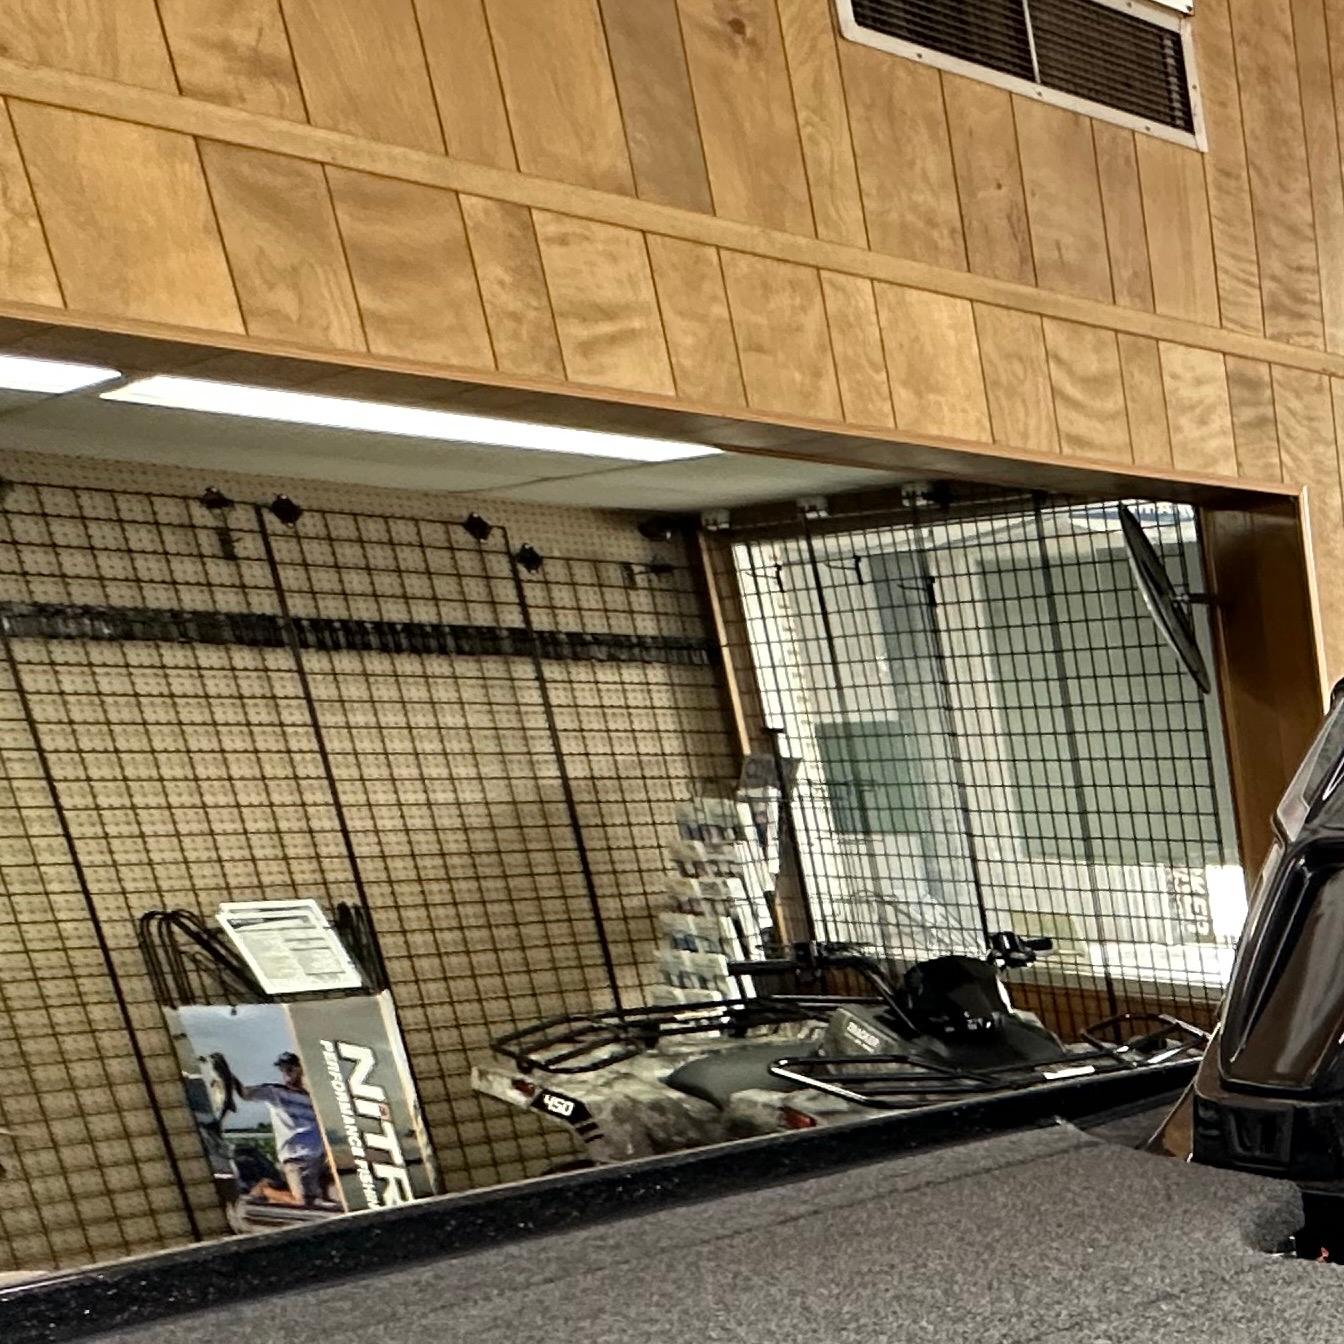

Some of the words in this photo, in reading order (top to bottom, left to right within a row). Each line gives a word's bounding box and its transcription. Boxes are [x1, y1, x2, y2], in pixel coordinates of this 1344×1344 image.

[337, 1041, 415, 1205] NITR
[543, 1094, 576, 1117] 450
[354, 1158, 381, 1209] FISHIN
